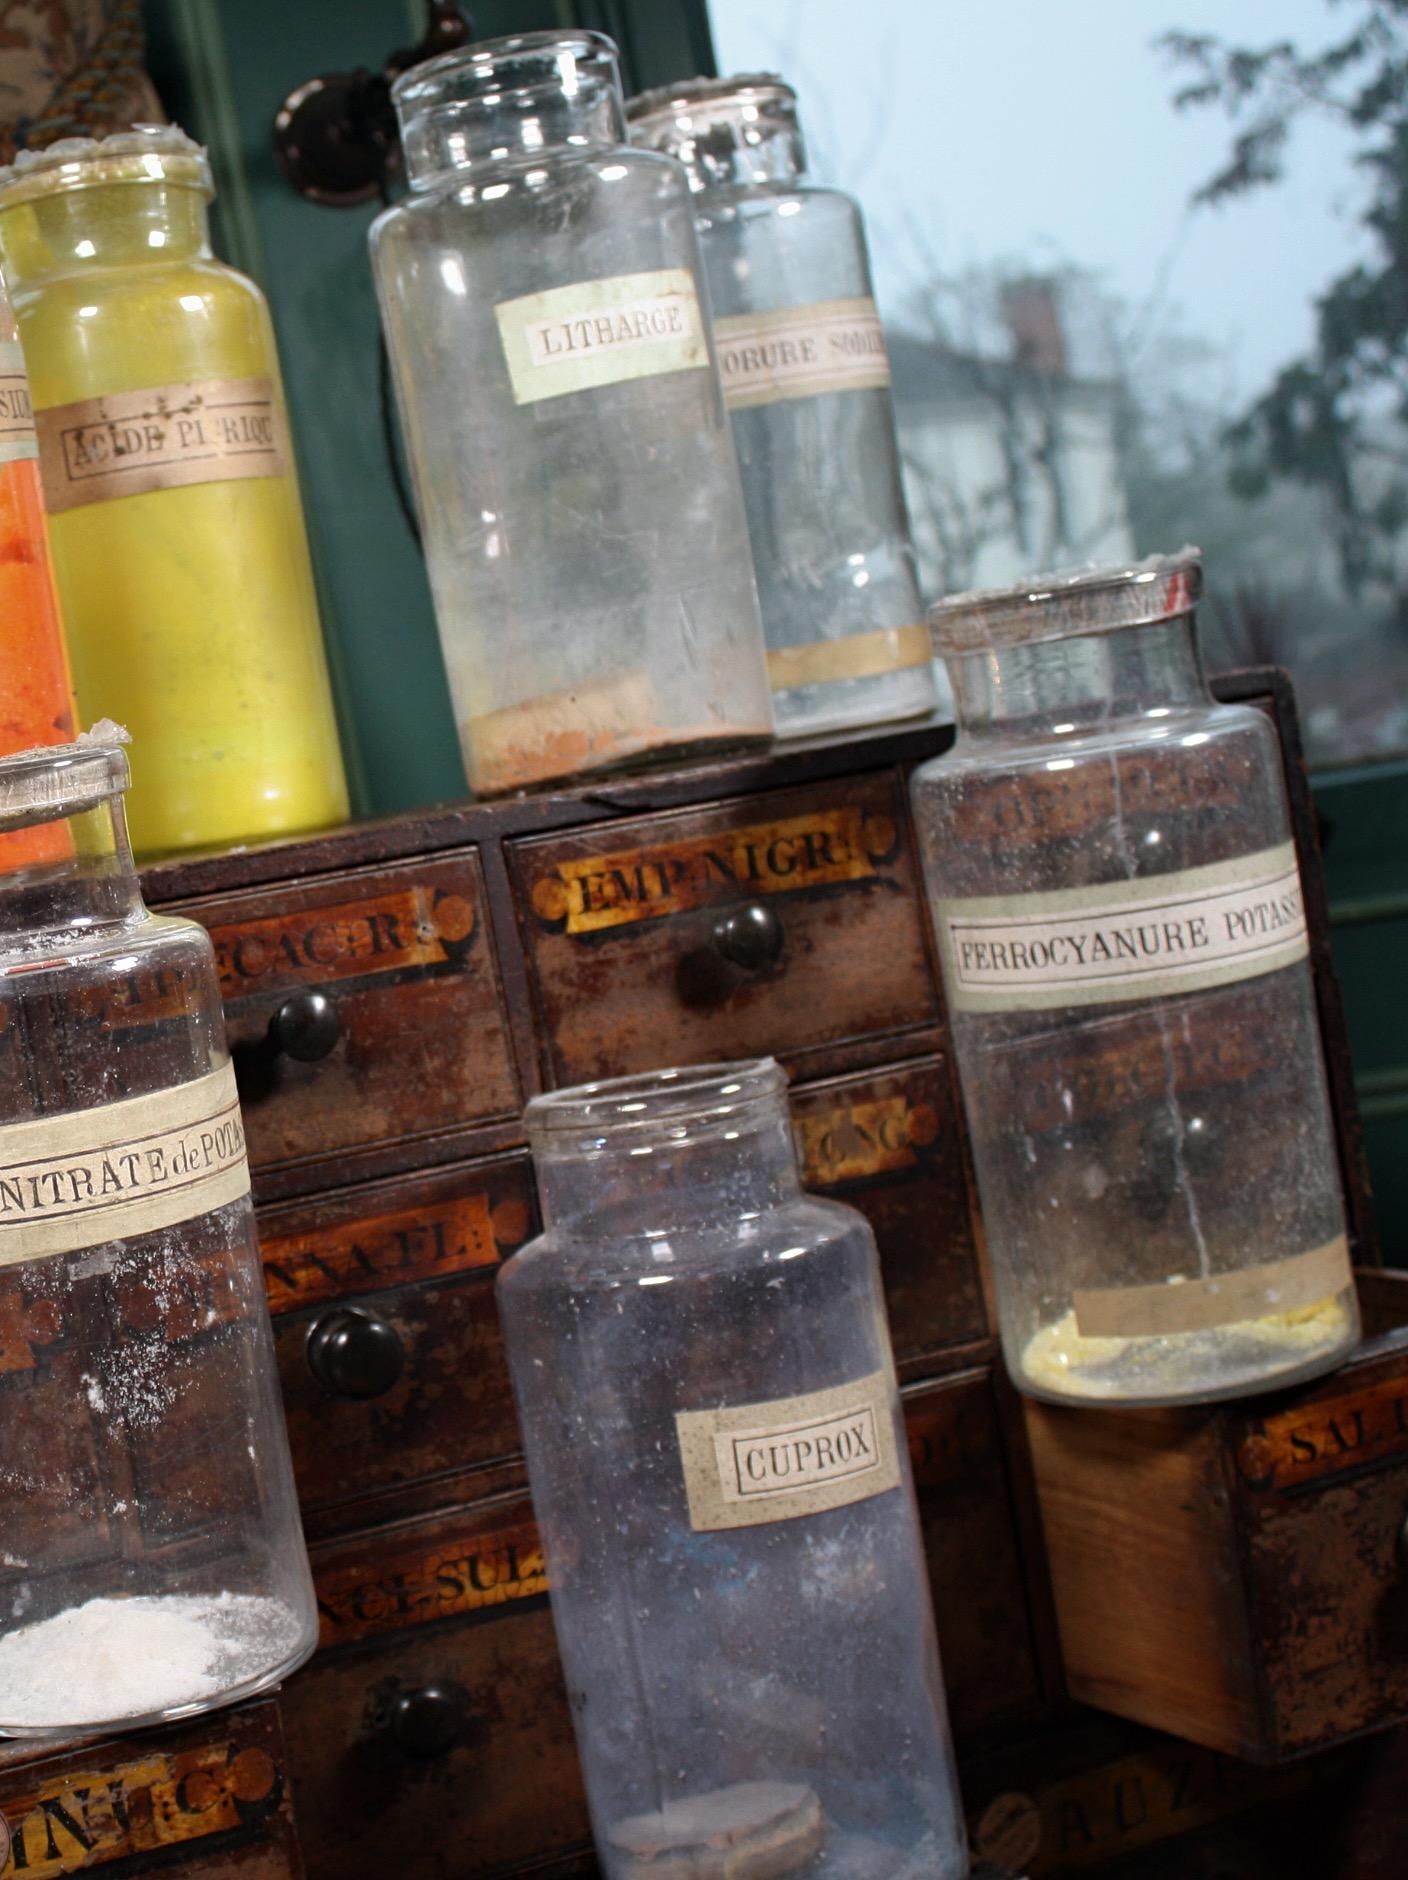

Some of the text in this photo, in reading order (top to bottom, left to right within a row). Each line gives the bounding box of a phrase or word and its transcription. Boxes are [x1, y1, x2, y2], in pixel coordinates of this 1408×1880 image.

[538, 306, 683, 356] LITHARGE
[960, 916, 1210, 971] FERROCYANURE
[172, 1139, 201, 1176] de
[746, 1422, 871, 1481] CUPROX
